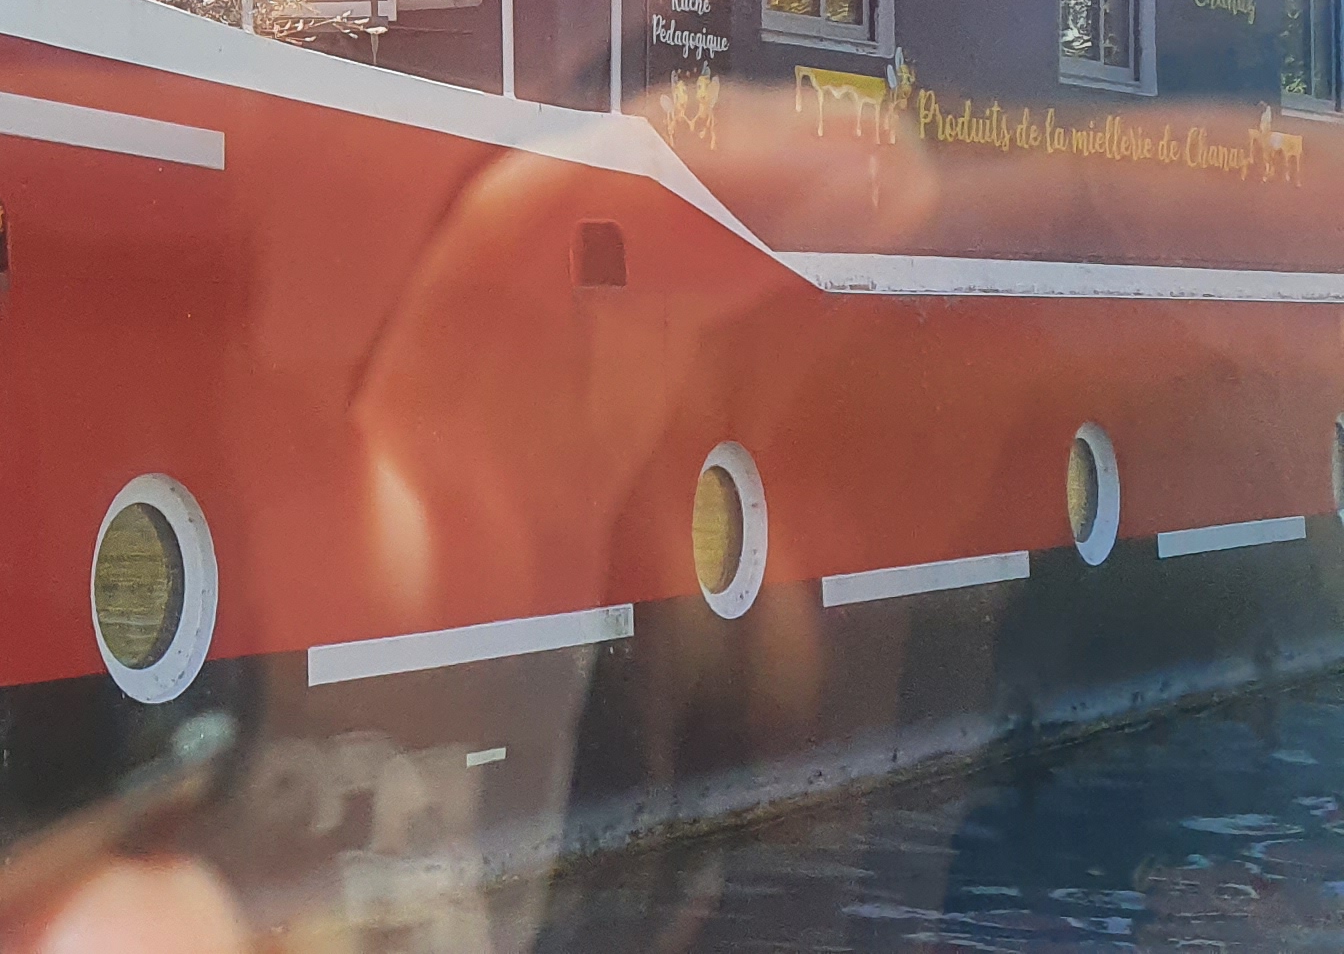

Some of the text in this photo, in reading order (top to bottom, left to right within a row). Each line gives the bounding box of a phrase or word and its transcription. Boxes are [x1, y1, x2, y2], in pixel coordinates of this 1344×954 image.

[652, 13, 730, 60] Pédagogique
[917, 89, 1011, 152] Produits
[1016, 107, 1042, 149] de
[1045, 107, 1068, 153] la
[1071, 114, 1155, 161] miellerie
[1158, 123, 1181, 163] de
